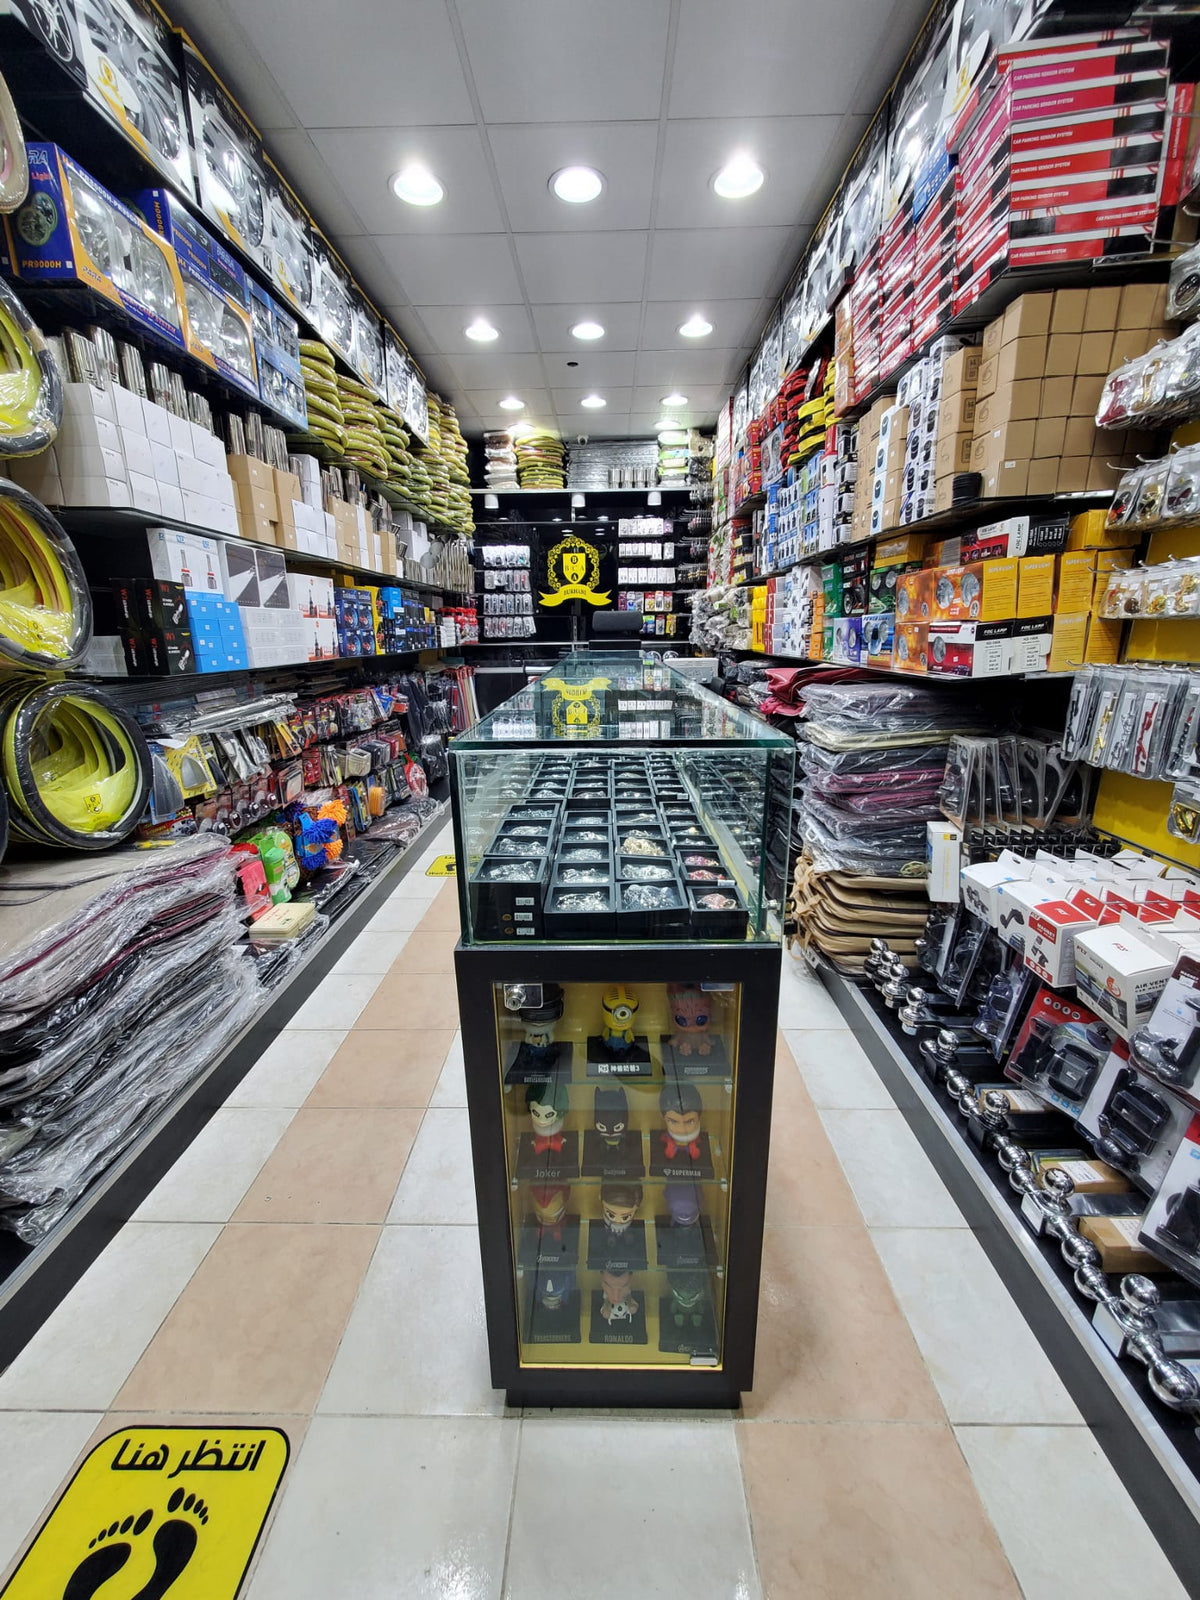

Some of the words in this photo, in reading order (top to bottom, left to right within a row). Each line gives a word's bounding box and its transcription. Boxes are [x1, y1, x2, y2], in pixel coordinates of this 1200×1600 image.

[534, 1168, 561, 1178] Joker
[672, 1169, 702, 1177] SUPERMAN
[604, 1334, 634, 1344] RONALDO
[110, 1438, 170, 1471] هنا
[167, 1439, 267, 1479] انتظر
